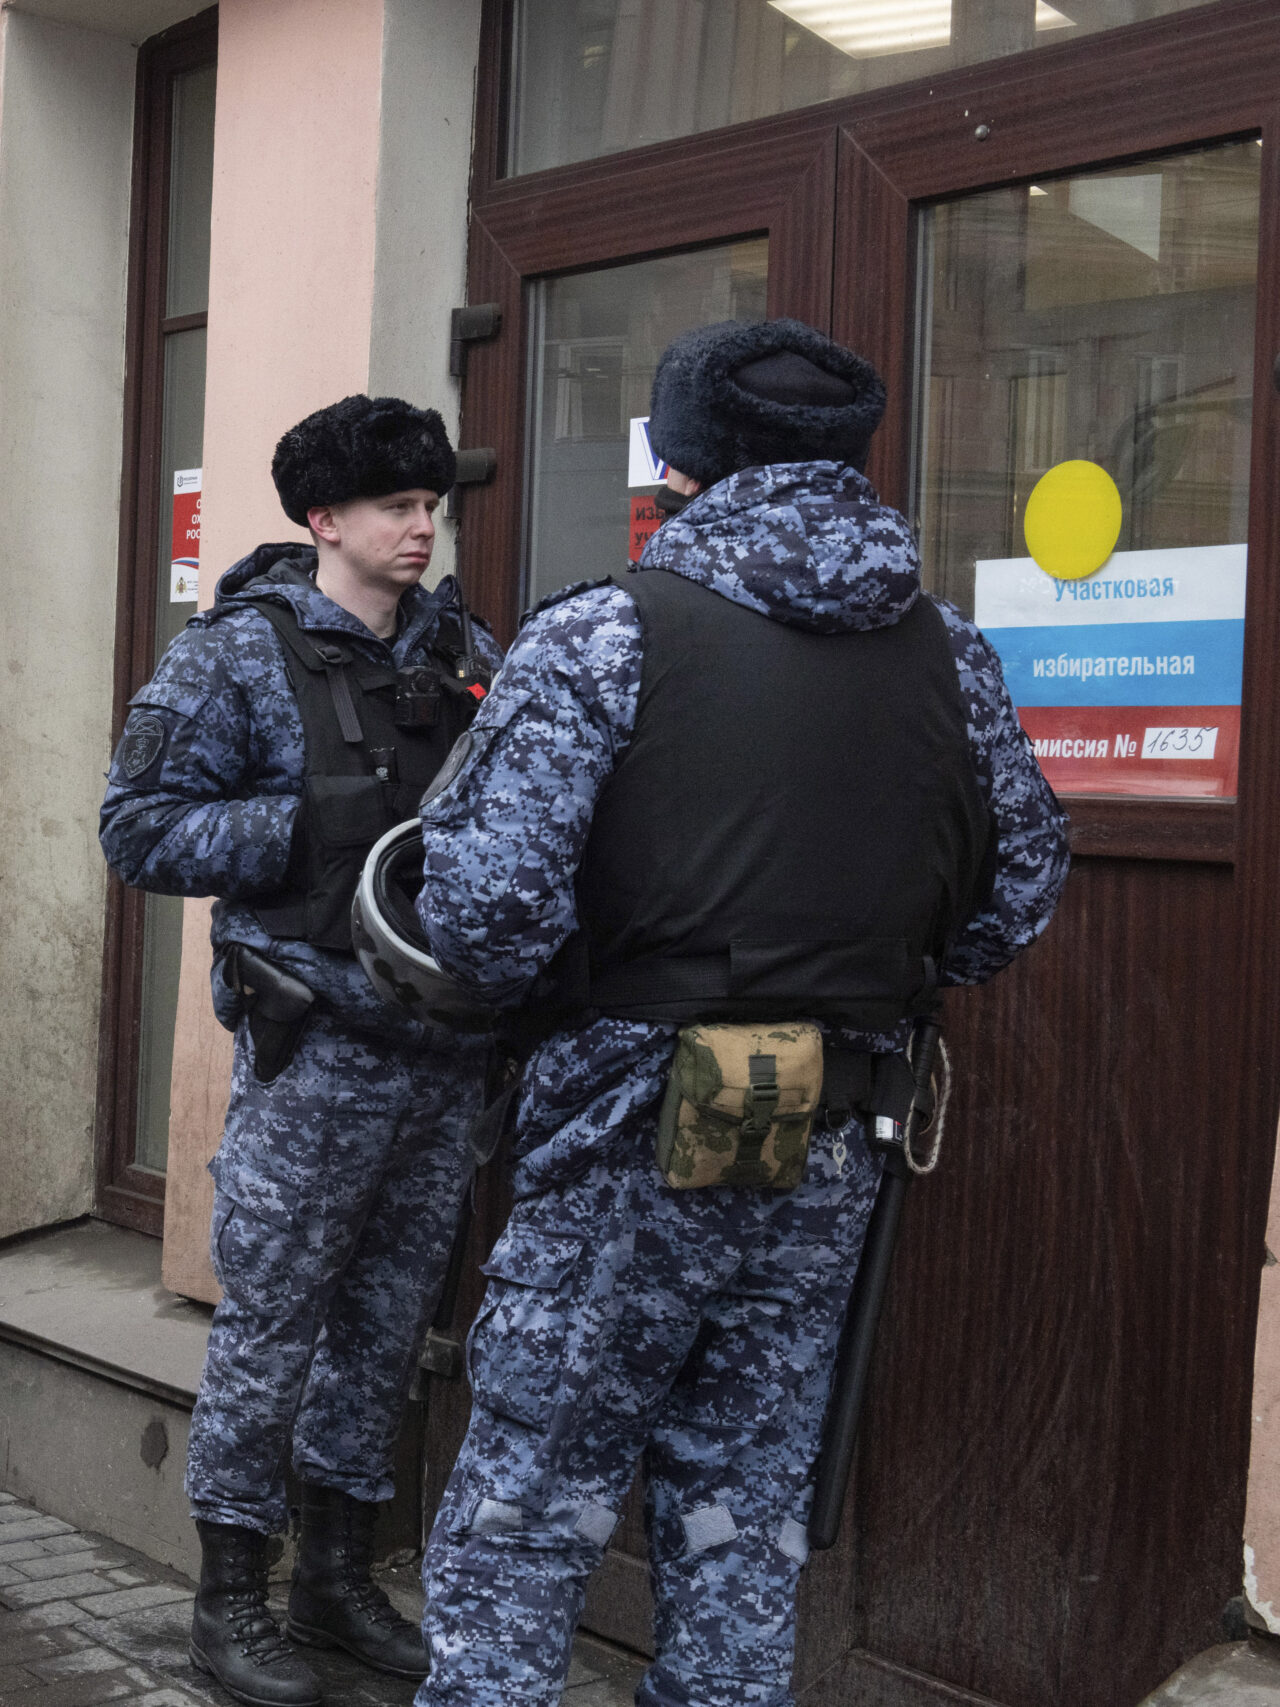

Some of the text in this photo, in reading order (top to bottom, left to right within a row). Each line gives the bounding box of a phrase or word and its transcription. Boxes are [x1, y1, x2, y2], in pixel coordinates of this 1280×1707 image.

[1033, 652, 1195, 682] избирательная
[1032, 734, 1138, 758] миссия №
[1146, 727, 1217, 752] 1635
